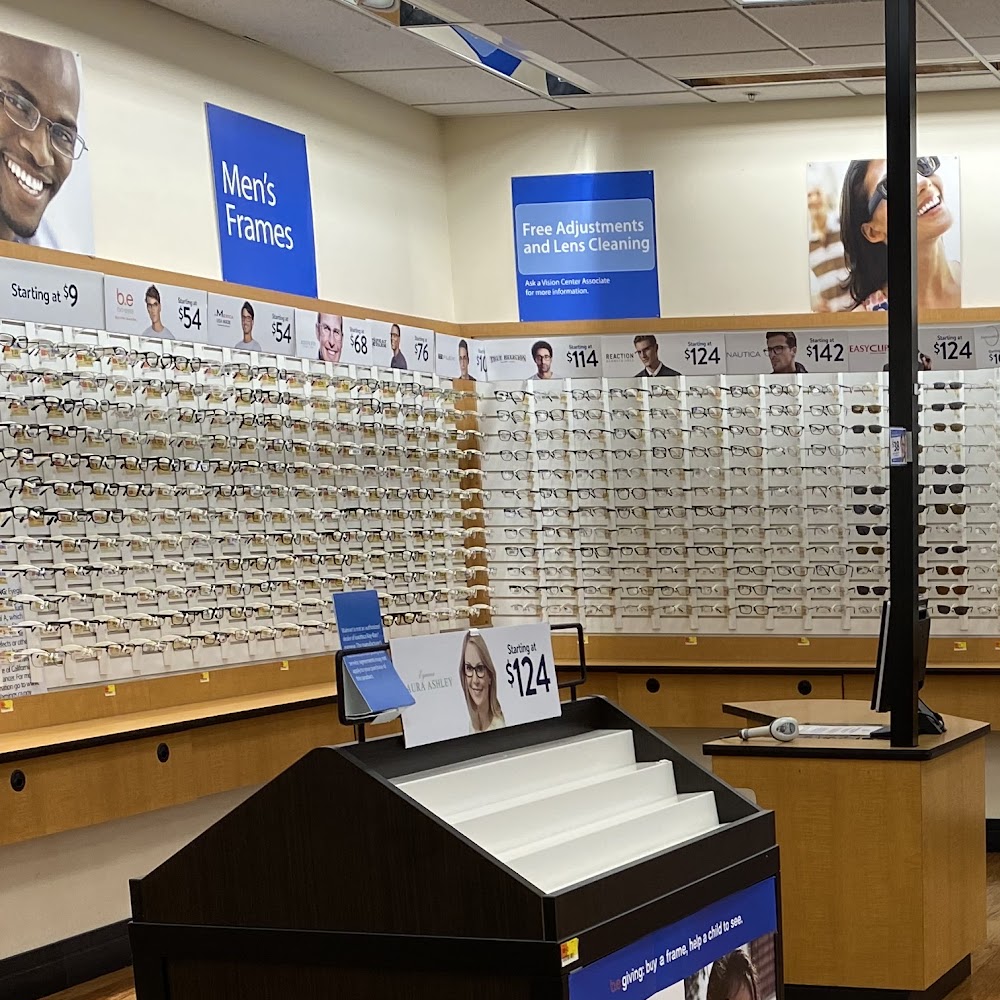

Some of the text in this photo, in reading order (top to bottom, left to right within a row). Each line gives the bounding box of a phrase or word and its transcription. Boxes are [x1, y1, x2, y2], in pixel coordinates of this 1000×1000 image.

[221, 160, 277, 207] Men's
[225, 202, 294, 250] Frames
[522, 219, 644, 238] Free Adjustments
[523, 236, 650, 254] and Lens Cleaning
[525, 279, 536, 287] Ask
[541, 278, 560, 286] Vision
[525, 288, 535, 296] for
[552, 287, 589, 295] information.
[11, 283, 78, 307] Starting at $9
[116, 288, 134, 306] b.e
[178, 306, 202, 331] $54
[271, 322, 292, 344] $54
[350, 335, 368, 355] $68
[414, 343, 429, 362] $76
[806, 343, 844, 362] $142
[933, 341, 972, 360] $124
[566, 349, 599, 368] $114
[684, 347, 721, 365] $124
[507, 643, 537, 655] Starting at
[427, 677, 453, 690] ASHLEY
[505, 654, 551, 698] $124
[621, 966, 645, 991] giving:
[645, 957, 658, 974] buy
[659, 957, 665, 966] a
[666, 943, 689, 964] frame,
[688, 935, 702, 952] help
[702, 933, 708, 944] a
[708, 922, 722, 941] child
[722, 920, 730, 933] to
[730, 914, 744, 928] see.
